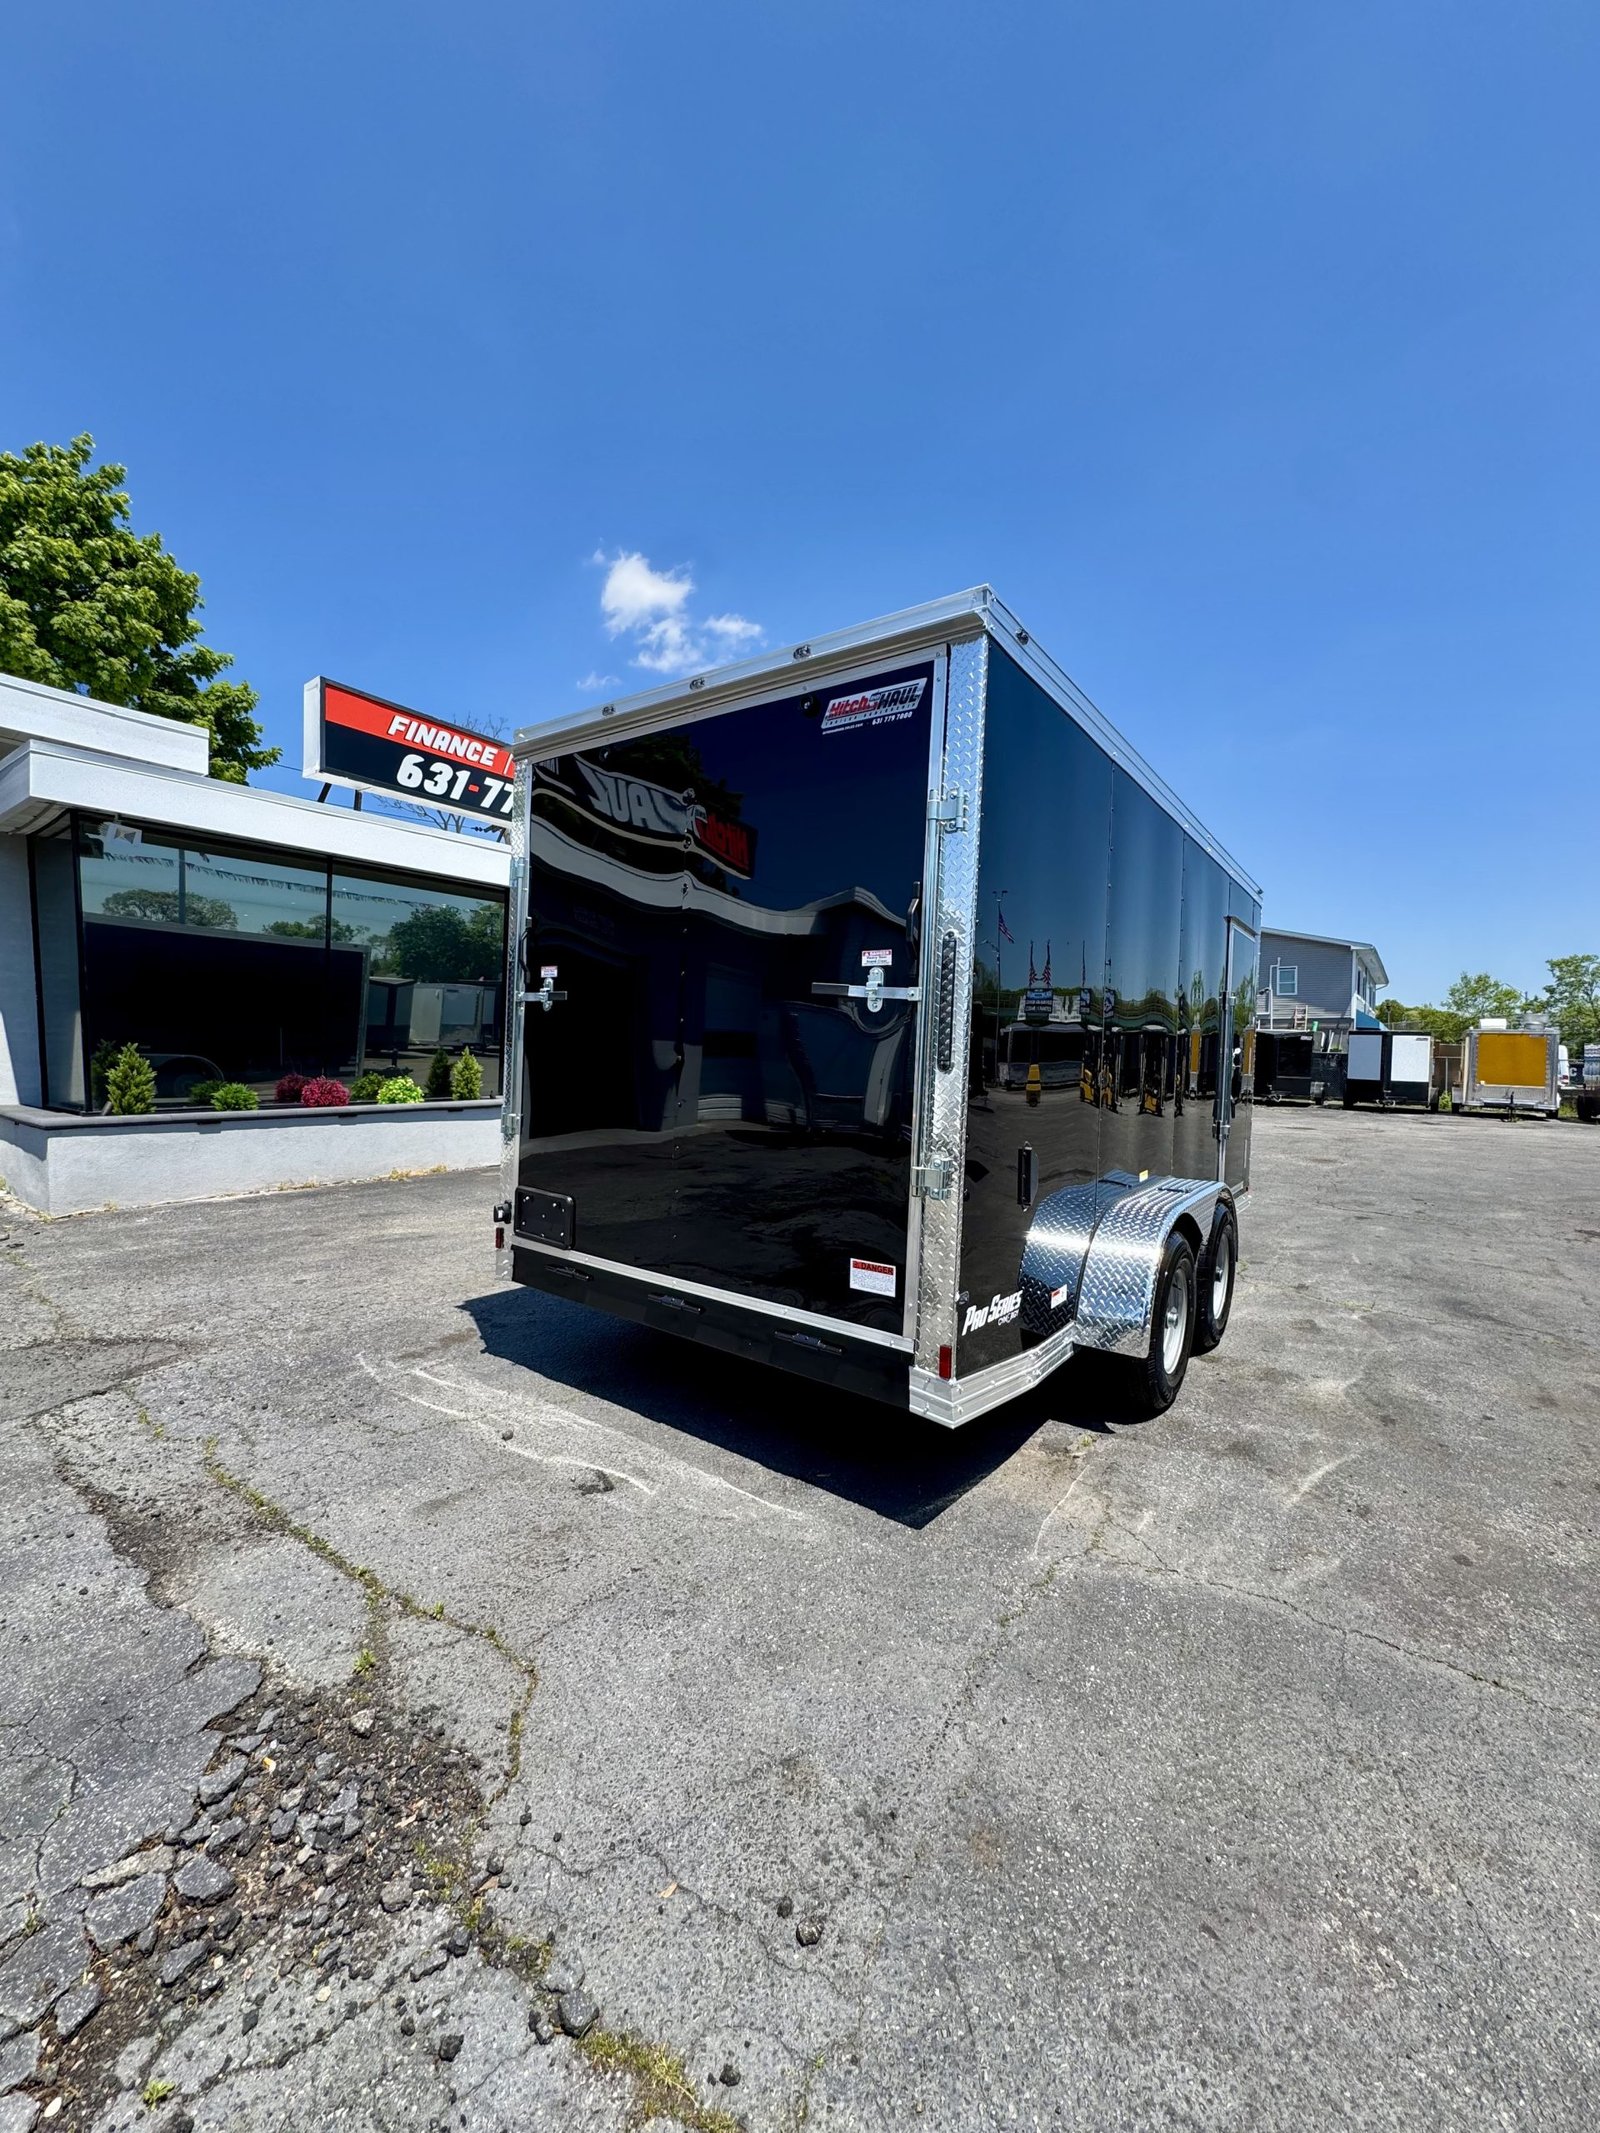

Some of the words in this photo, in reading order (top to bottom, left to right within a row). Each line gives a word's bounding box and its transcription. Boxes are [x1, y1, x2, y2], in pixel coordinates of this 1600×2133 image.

[877, 686, 920, 709] HAUL
[387, 715, 499, 767] FINANCE
[862, 1263, 894, 1275] DANGER
[961, 1305, 989, 1336] PRO
[987, 1290, 1023, 1323] SERIES
